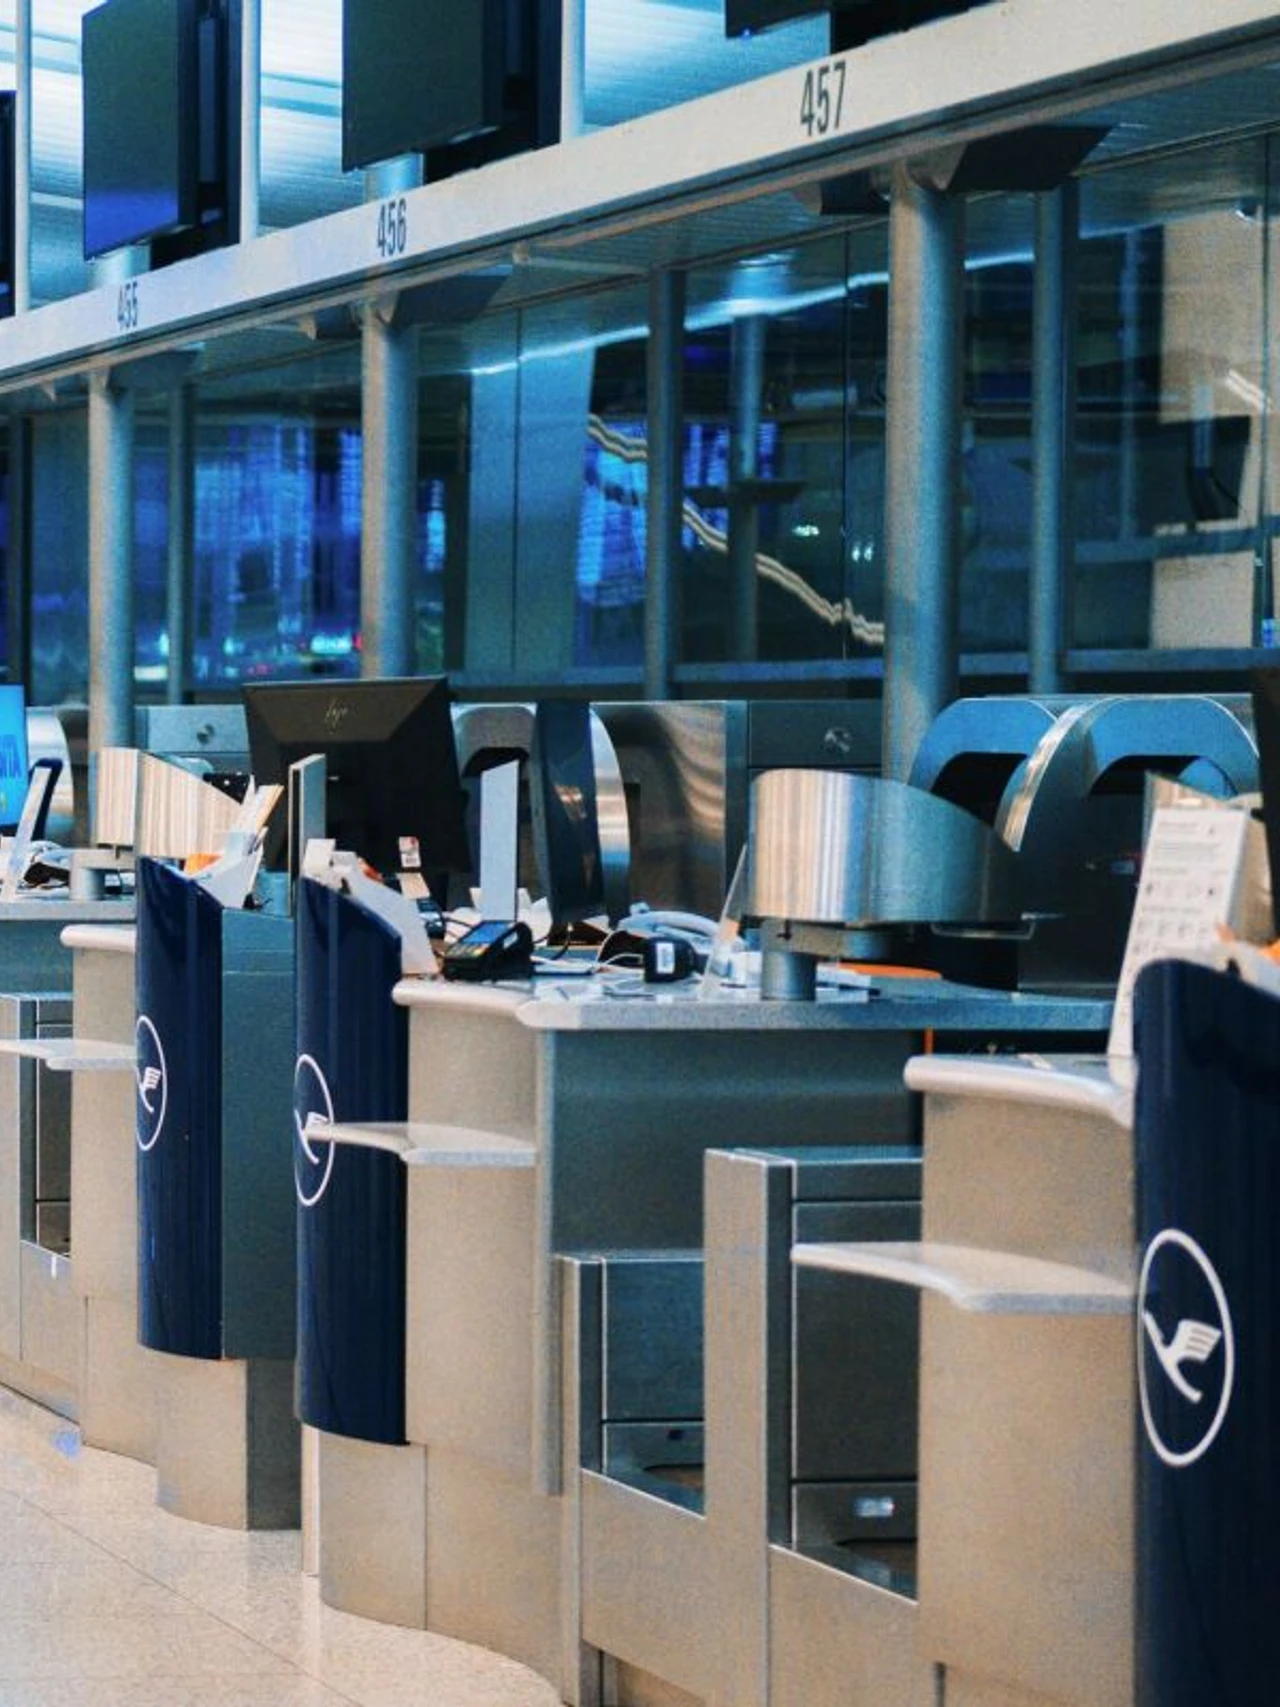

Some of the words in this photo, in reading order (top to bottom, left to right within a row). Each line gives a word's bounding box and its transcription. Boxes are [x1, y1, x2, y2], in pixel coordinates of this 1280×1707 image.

[801, 60, 846, 137] 457
[377, 198, 407, 257] 456
[118, 281, 138, 330] 455
